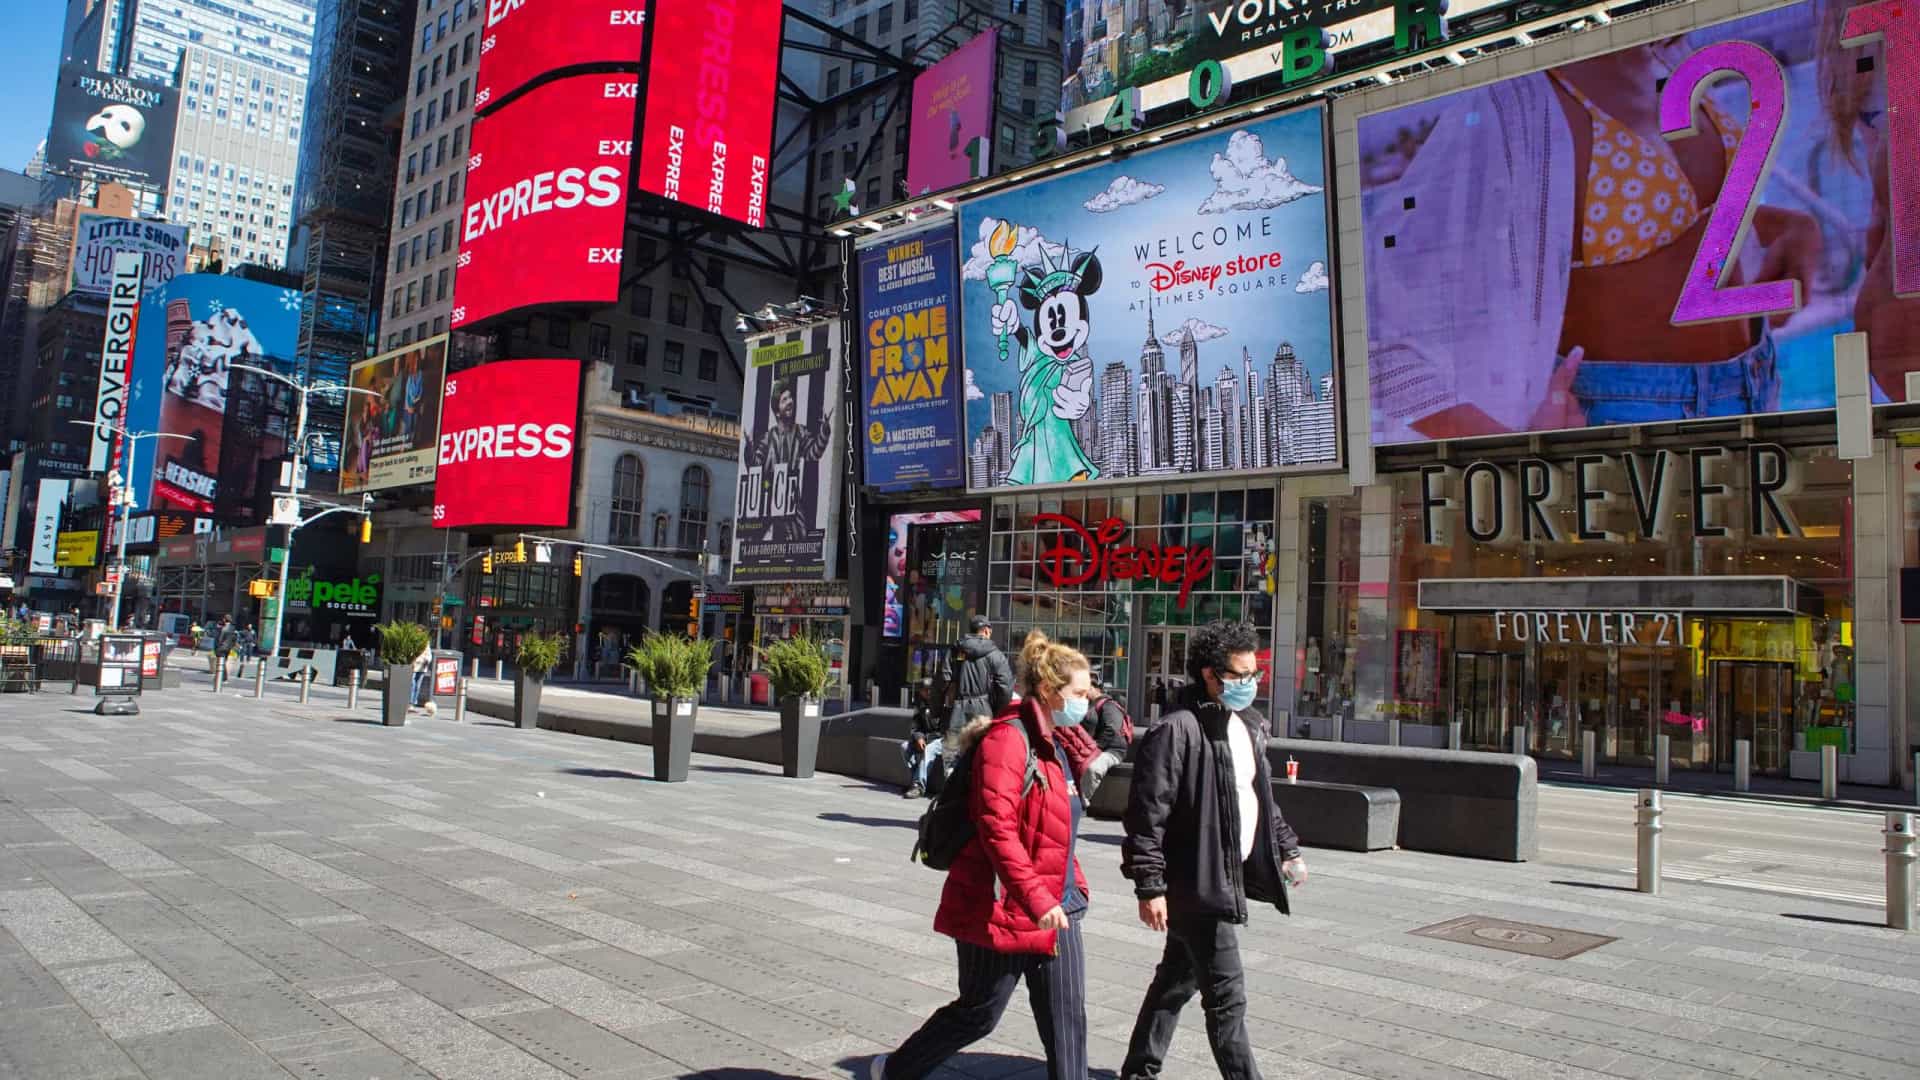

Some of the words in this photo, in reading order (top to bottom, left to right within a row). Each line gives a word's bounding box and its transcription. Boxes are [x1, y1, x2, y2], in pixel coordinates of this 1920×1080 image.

[1241, 11, 1312, 42] REALTY
[80, 76, 160, 104] PHANTOM
[1656, 0, 1920, 326] 21
[464, 165, 622, 242] EXPRESS
[89, 221, 142, 241] LITTLE
[144, 225, 180, 251] SHOP
[887, 240, 924, 264] WINNER!
[1134, 216, 1272, 261] WELCOME
[85, 243, 176, 284] HOORS
[878, 264, 898, 282] BEST
[899, 255, 935, 278] MUSICAL
[1131, 280, 1141, 288] TO
[1144, 260, 1222, 292] Disney
[1226, 251, 1282, 276] store
[868, 308, 890, 319] COME
[893, 299, 934, 314] TOGETHER
[935, 294, 947, 304] AT
[1129, 300, 1145, 312] AT
[1157, 290, 1205, 307] TIMES
[1218, 274, 1288, 297] SQUARE
[868, 306, 947, 346] COME
[97, 263, 139, 443] COVERGIRL
[870, 367, 949, 407] AWAY
[438, 423, 572, 466] EXPRESS
[1420, 442, 1805, 545] FOREVER
[495, 552, 527, 564] EXPRS
[1033, 511, 1214, 609] Disney
[312, 574, 381, 608] pelé
[326, 602, 368, 611] SOCCER
[1495, 611, 1637, 645] FOREVER
[1654, 612, 1684, 646] 21
